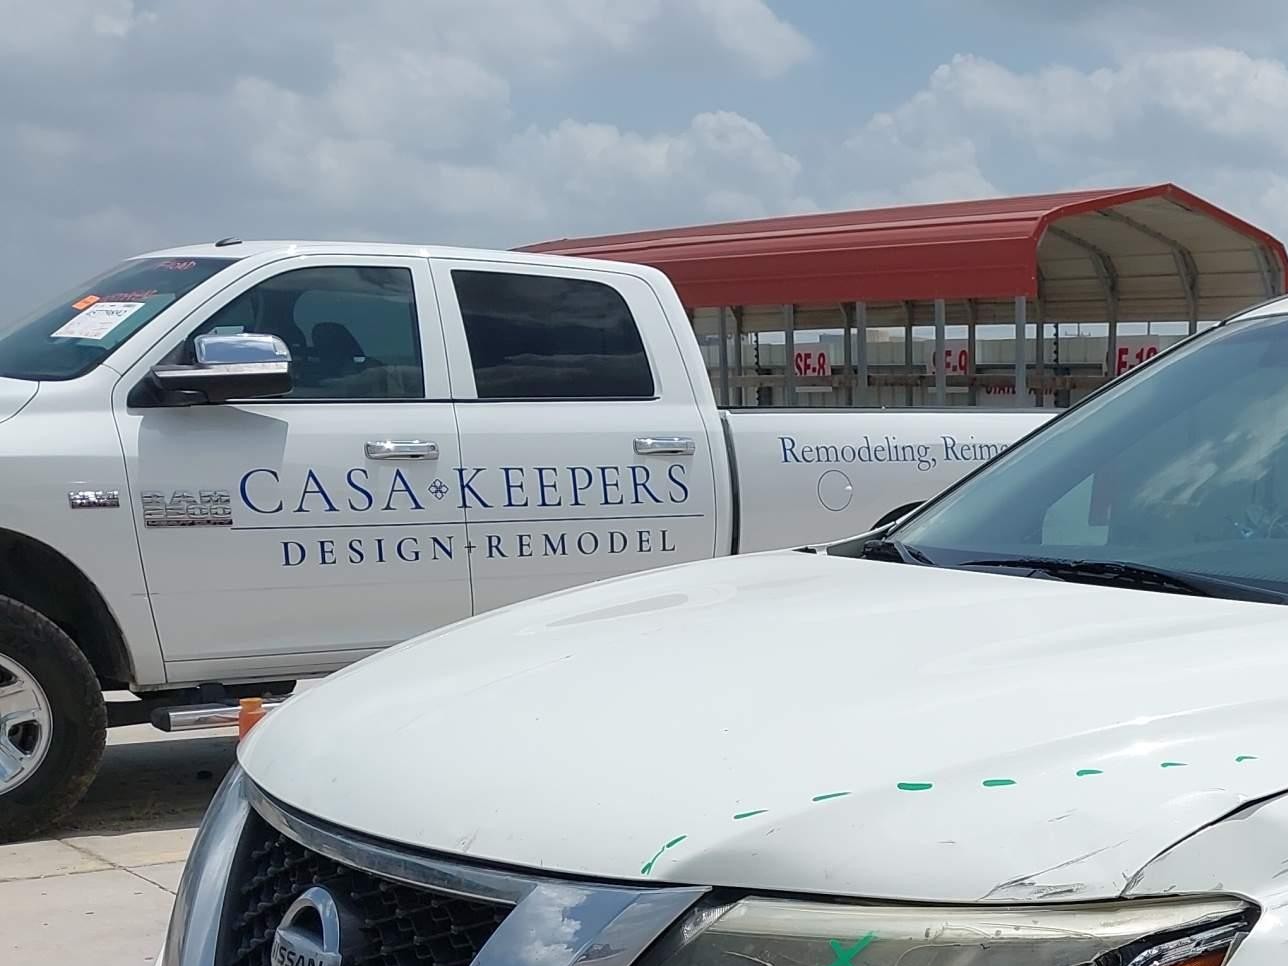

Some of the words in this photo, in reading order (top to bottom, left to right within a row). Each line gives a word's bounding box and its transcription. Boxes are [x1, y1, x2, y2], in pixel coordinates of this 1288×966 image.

[794, 352, 826, 376] SF-8
[932, 350, 968, 375] F-9
[778, 435, 937, 471] Remodeling,
[239, 467, 425, 514] CASA
[453, 463, 690, 509] KEEPERS
[281, 535, 454, 567] DESIGN
[485, 529, 676, 559] REMODEL
